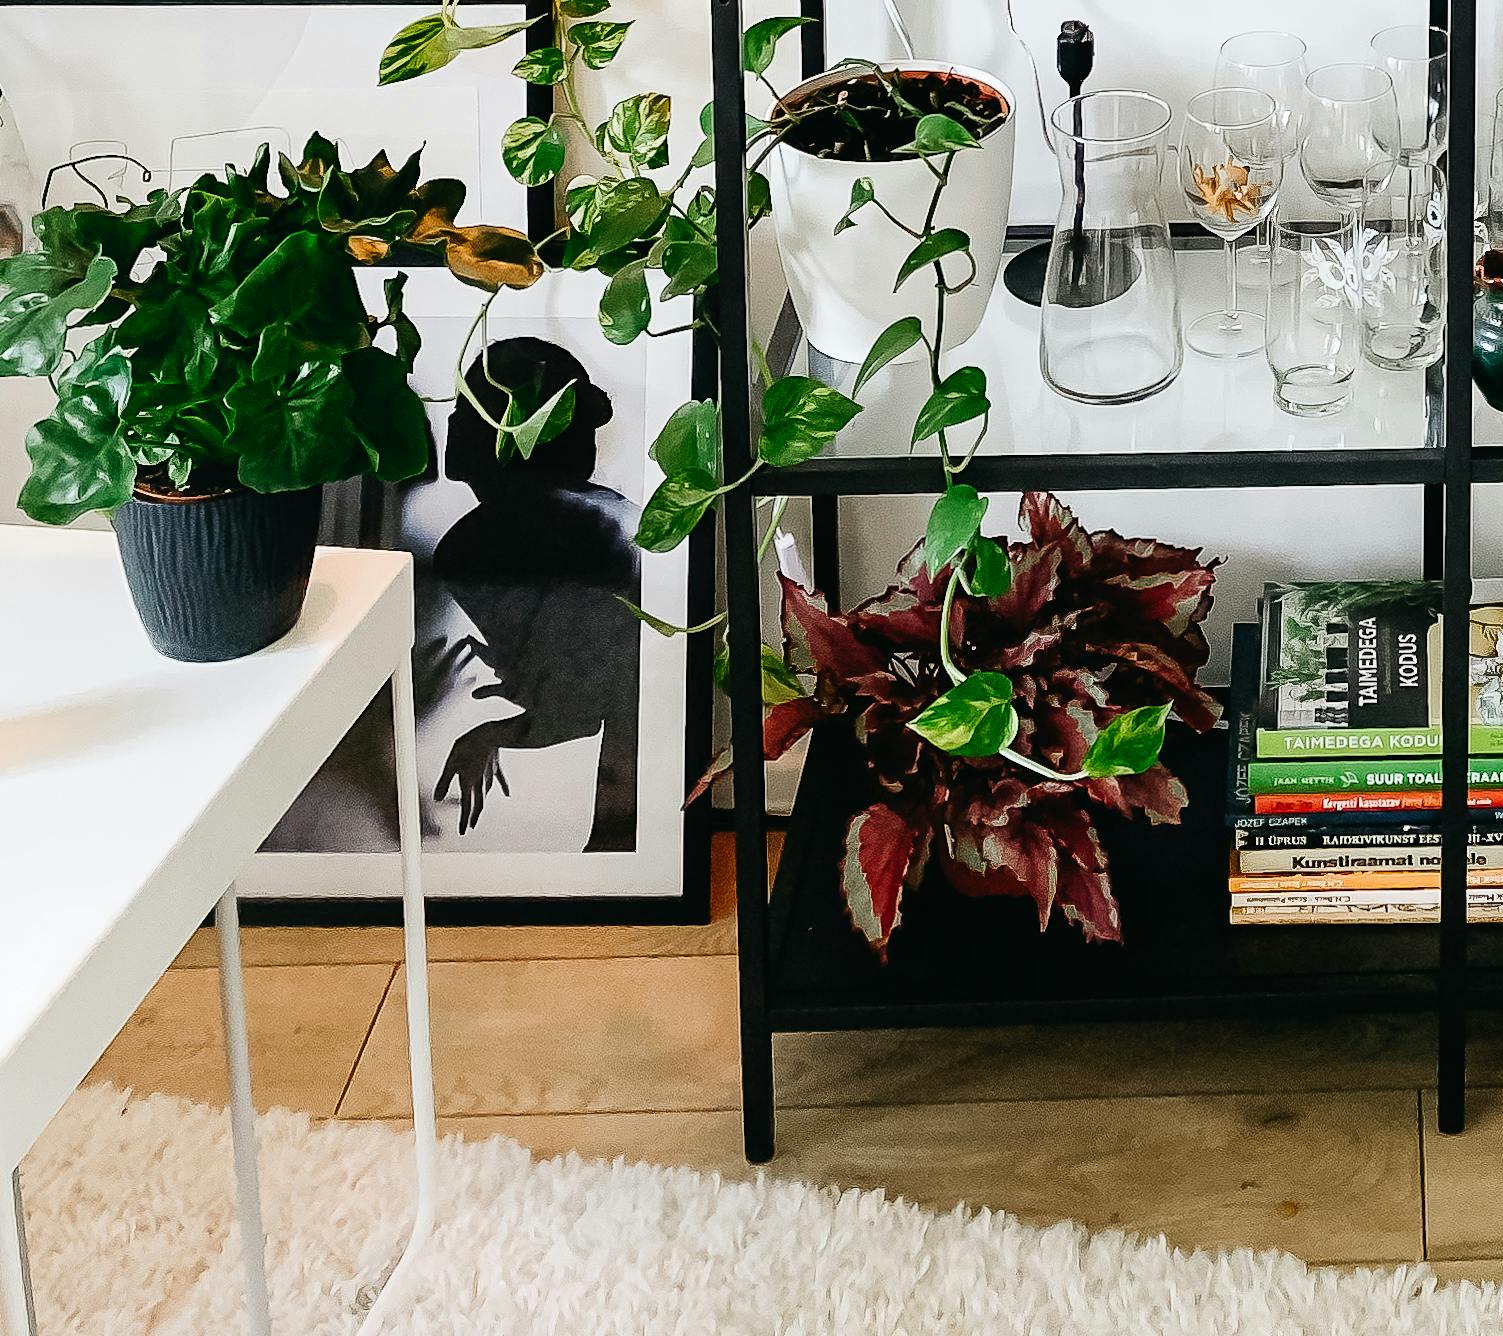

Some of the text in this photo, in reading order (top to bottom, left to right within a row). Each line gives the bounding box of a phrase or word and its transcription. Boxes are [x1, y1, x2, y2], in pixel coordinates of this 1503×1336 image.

[1357, 616, 1378, 708] TAIMEDEGA
[1397, 632, 1420, 688] KODUS
[1283, 734, 1441, 750] TAIMEDEGA KODU
[1366, 773, 1404, 786] SUUR
[1291, 853, 1414, 870] Kunstiraamat
